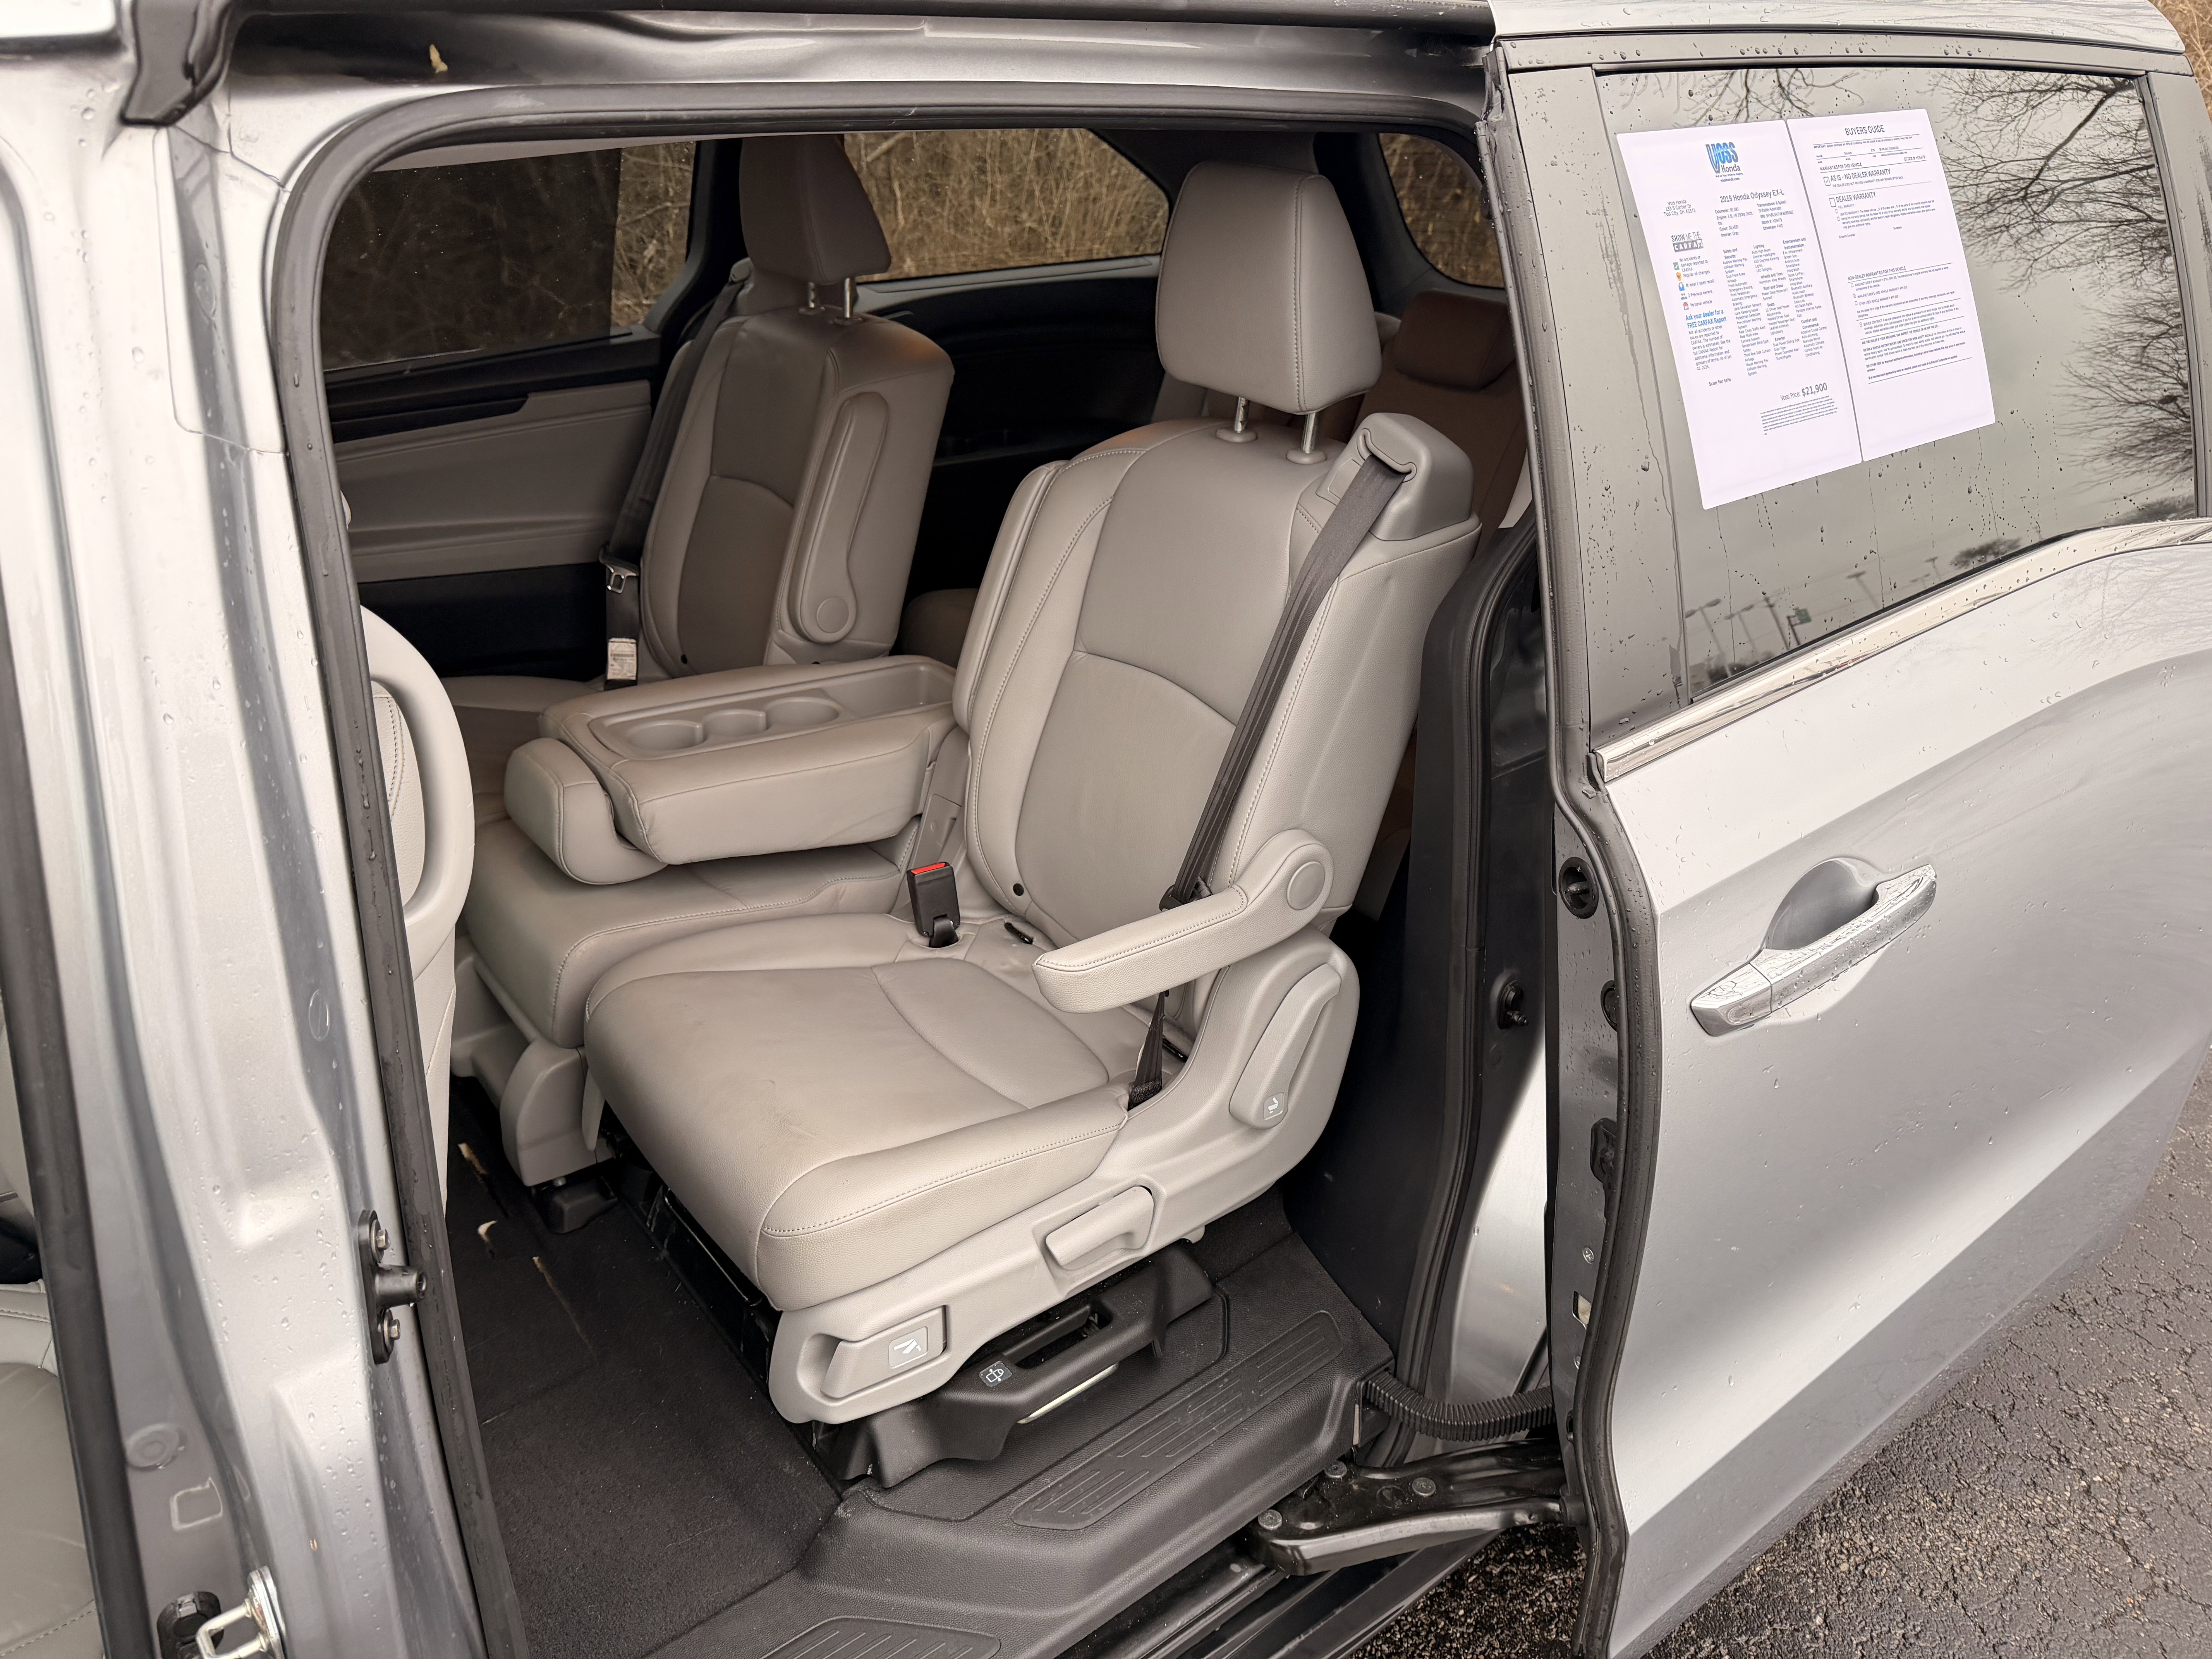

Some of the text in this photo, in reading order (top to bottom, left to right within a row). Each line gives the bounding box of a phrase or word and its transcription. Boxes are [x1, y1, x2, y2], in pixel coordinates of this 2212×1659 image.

[1844, 125, 1885, 136] BUYERS GUIDE
[1705, 142, 1738, 173] VOSS
[1721, 163, 1741, 173] Honda
[1867, 168, 1890, 177] WARRANTY
[1733, 193, 1750, 201] Honda
[1750, 191, 1771, 200] Odyssey
[1836, 191, 1875, 203] DEALER WARRANTY
[1673, 239, 1703, 252] CARFAX
[1697, 318, 1714, 326] CARFAX
[1802, 382, 1827, 397] $21,900
